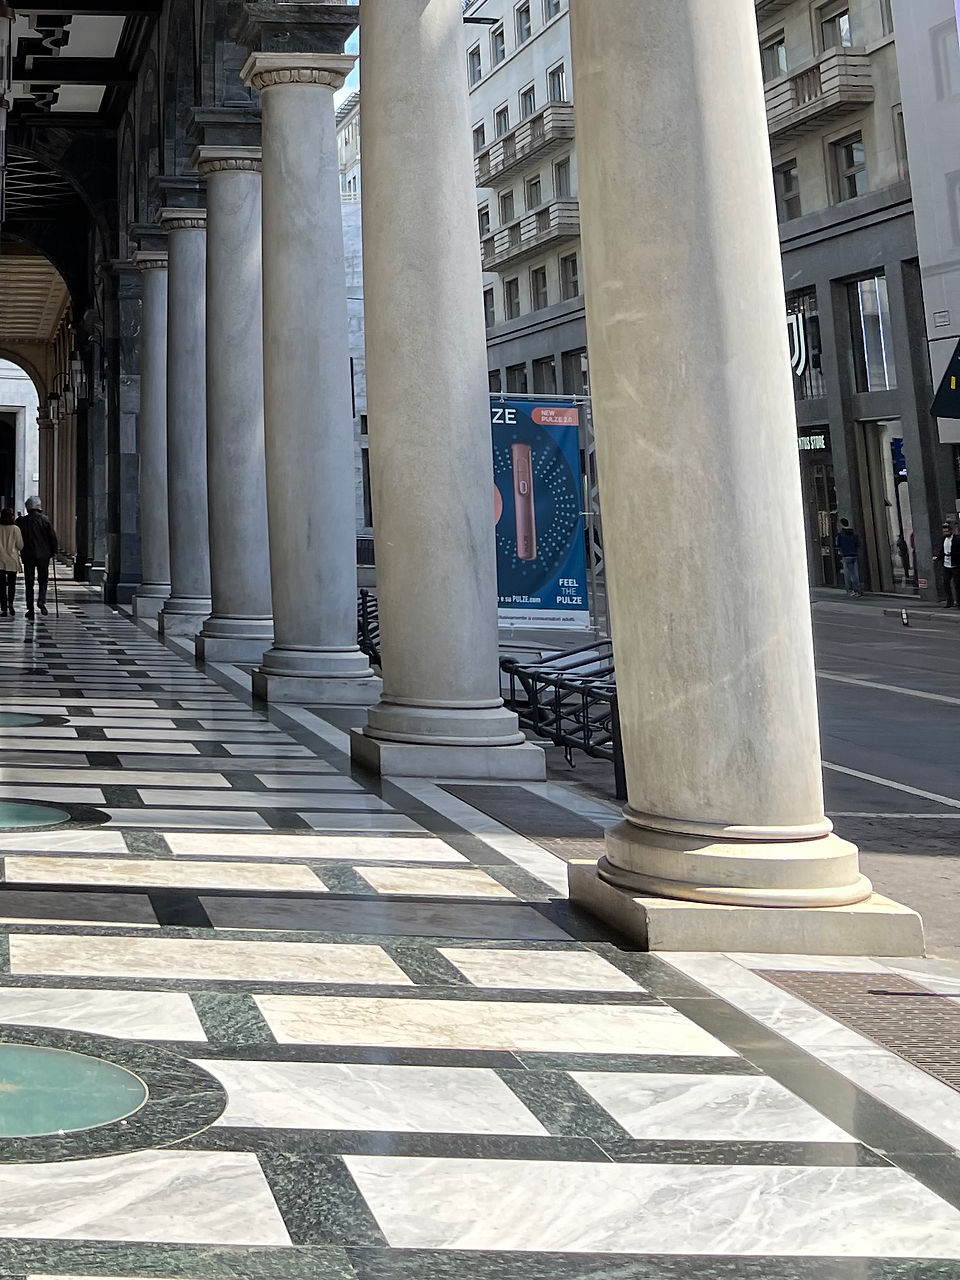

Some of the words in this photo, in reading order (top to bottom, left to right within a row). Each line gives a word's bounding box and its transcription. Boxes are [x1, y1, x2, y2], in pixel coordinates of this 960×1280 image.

[559, 578, 579, 587] FEEL
[561, 587, 576, 595] THE
[512, 595, 541, 603] PULZE.com
[556, 596, 583, 604] PULZE
